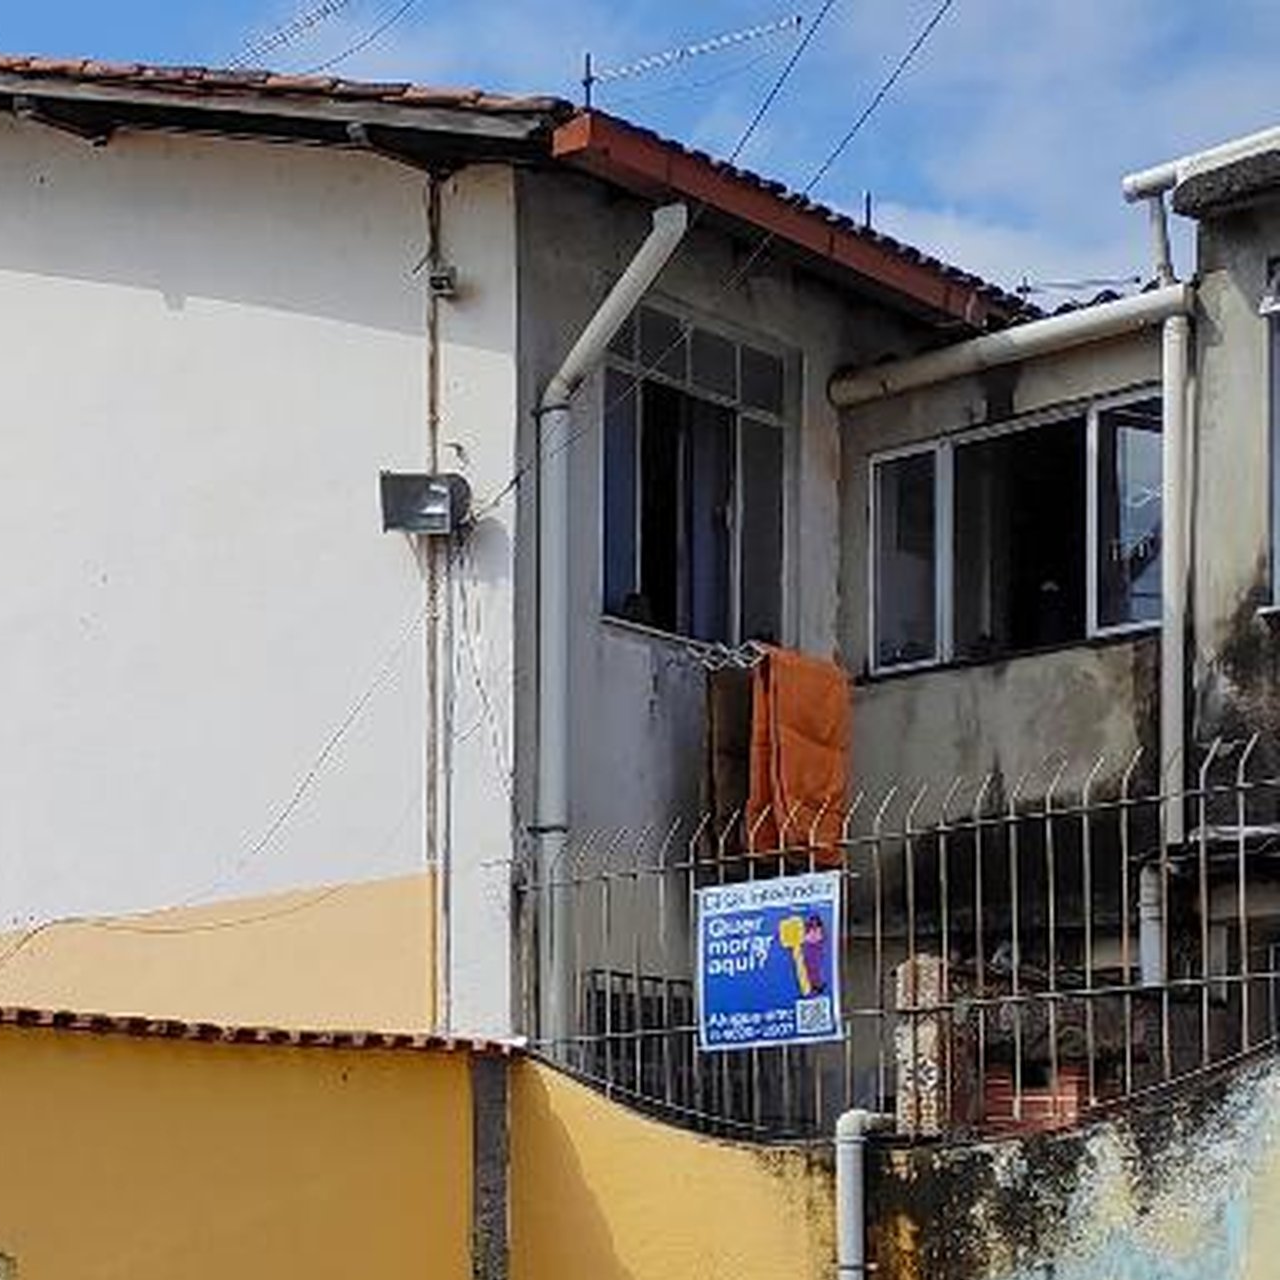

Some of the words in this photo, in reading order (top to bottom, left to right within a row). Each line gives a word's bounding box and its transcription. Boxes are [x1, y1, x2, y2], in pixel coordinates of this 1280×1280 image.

[708, 917, 763, 938] Quer
[708, 936, 774, 955] morar
[708, 949, 768, 976] aqui?
